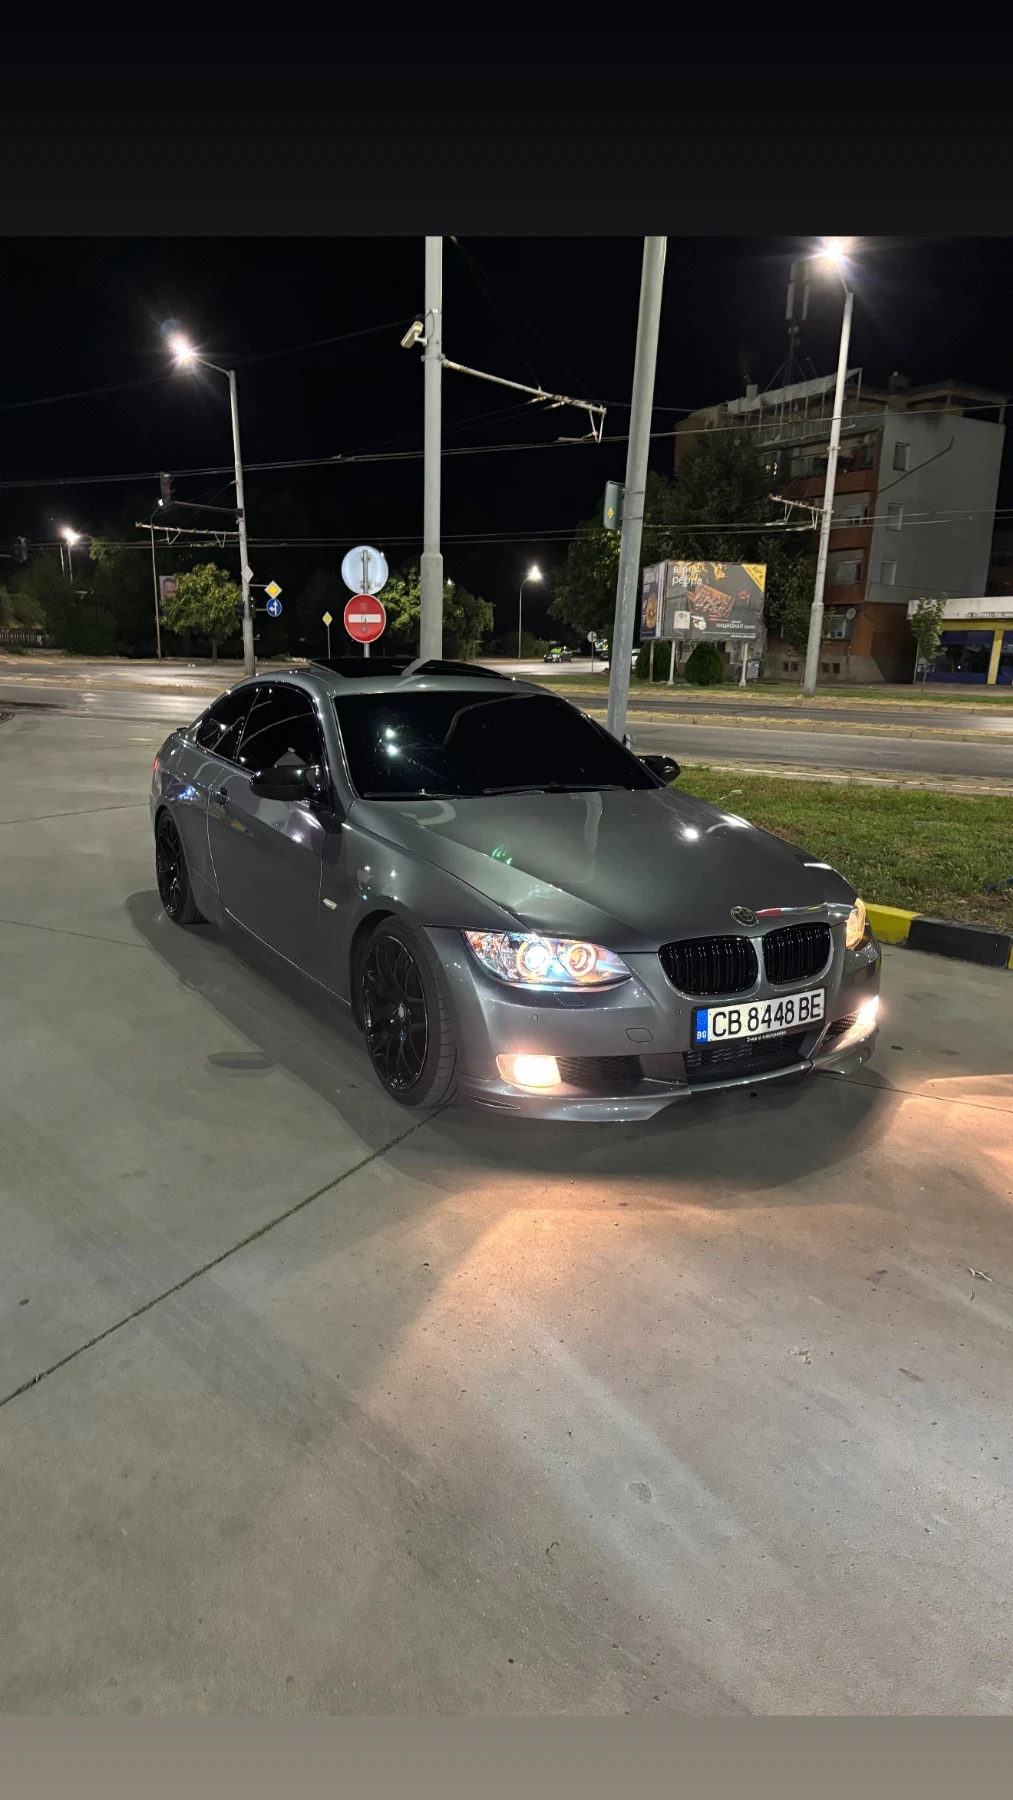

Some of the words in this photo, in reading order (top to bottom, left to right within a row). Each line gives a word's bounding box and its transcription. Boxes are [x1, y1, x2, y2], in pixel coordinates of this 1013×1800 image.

[712, 1010, 742, 1037] CB
[747, 1000, 795, 1032] 8448
[799, 993, 822, 1022] BE
[696, 1031, 707, 1039] BG
